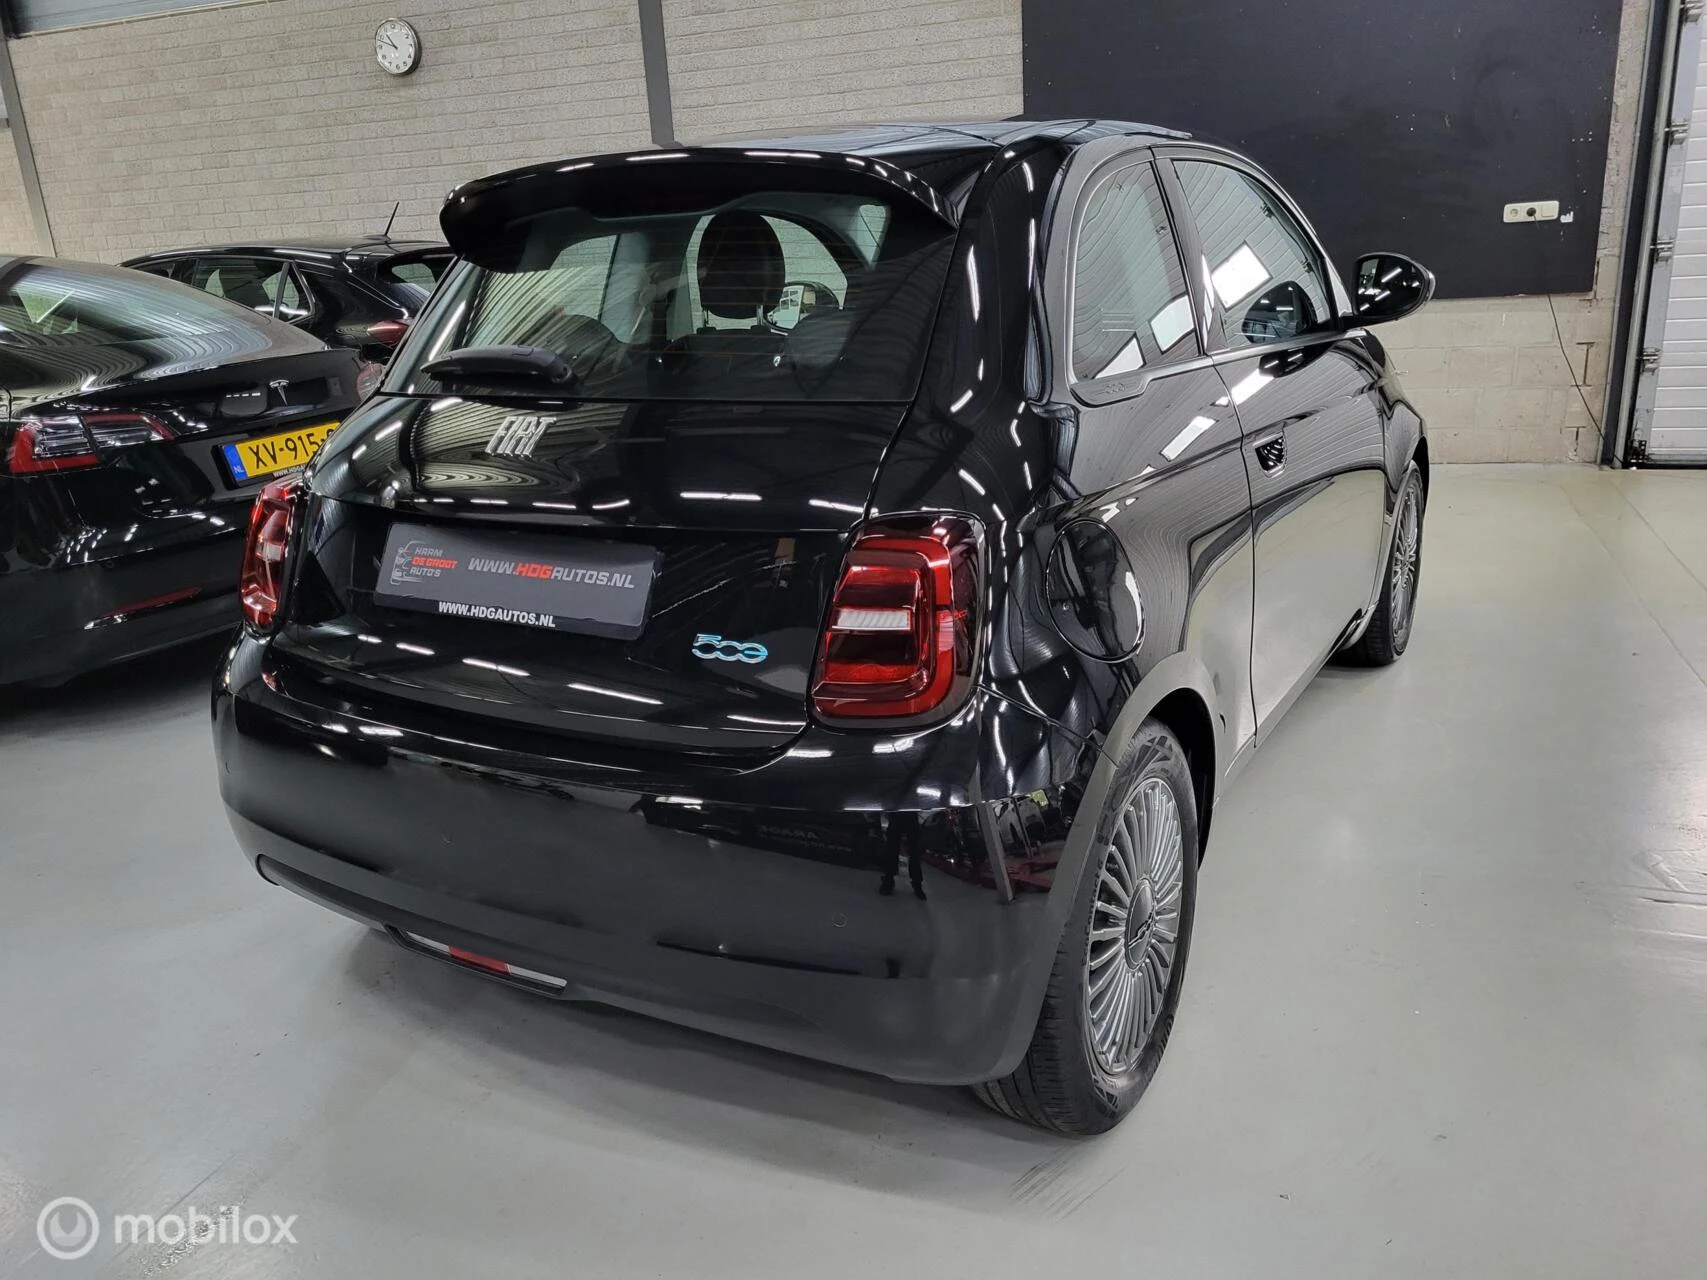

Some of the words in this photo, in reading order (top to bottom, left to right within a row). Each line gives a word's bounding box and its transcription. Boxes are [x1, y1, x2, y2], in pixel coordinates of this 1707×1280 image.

[485, 416, 557, 458] FIAT
[233, 465, 245, 474] NL
[425, 558, 458, 569] GROOT
[438, 601, 555, 628] WWW.HDGAUTOS.NL
[691, 633, 768, 664] 500
